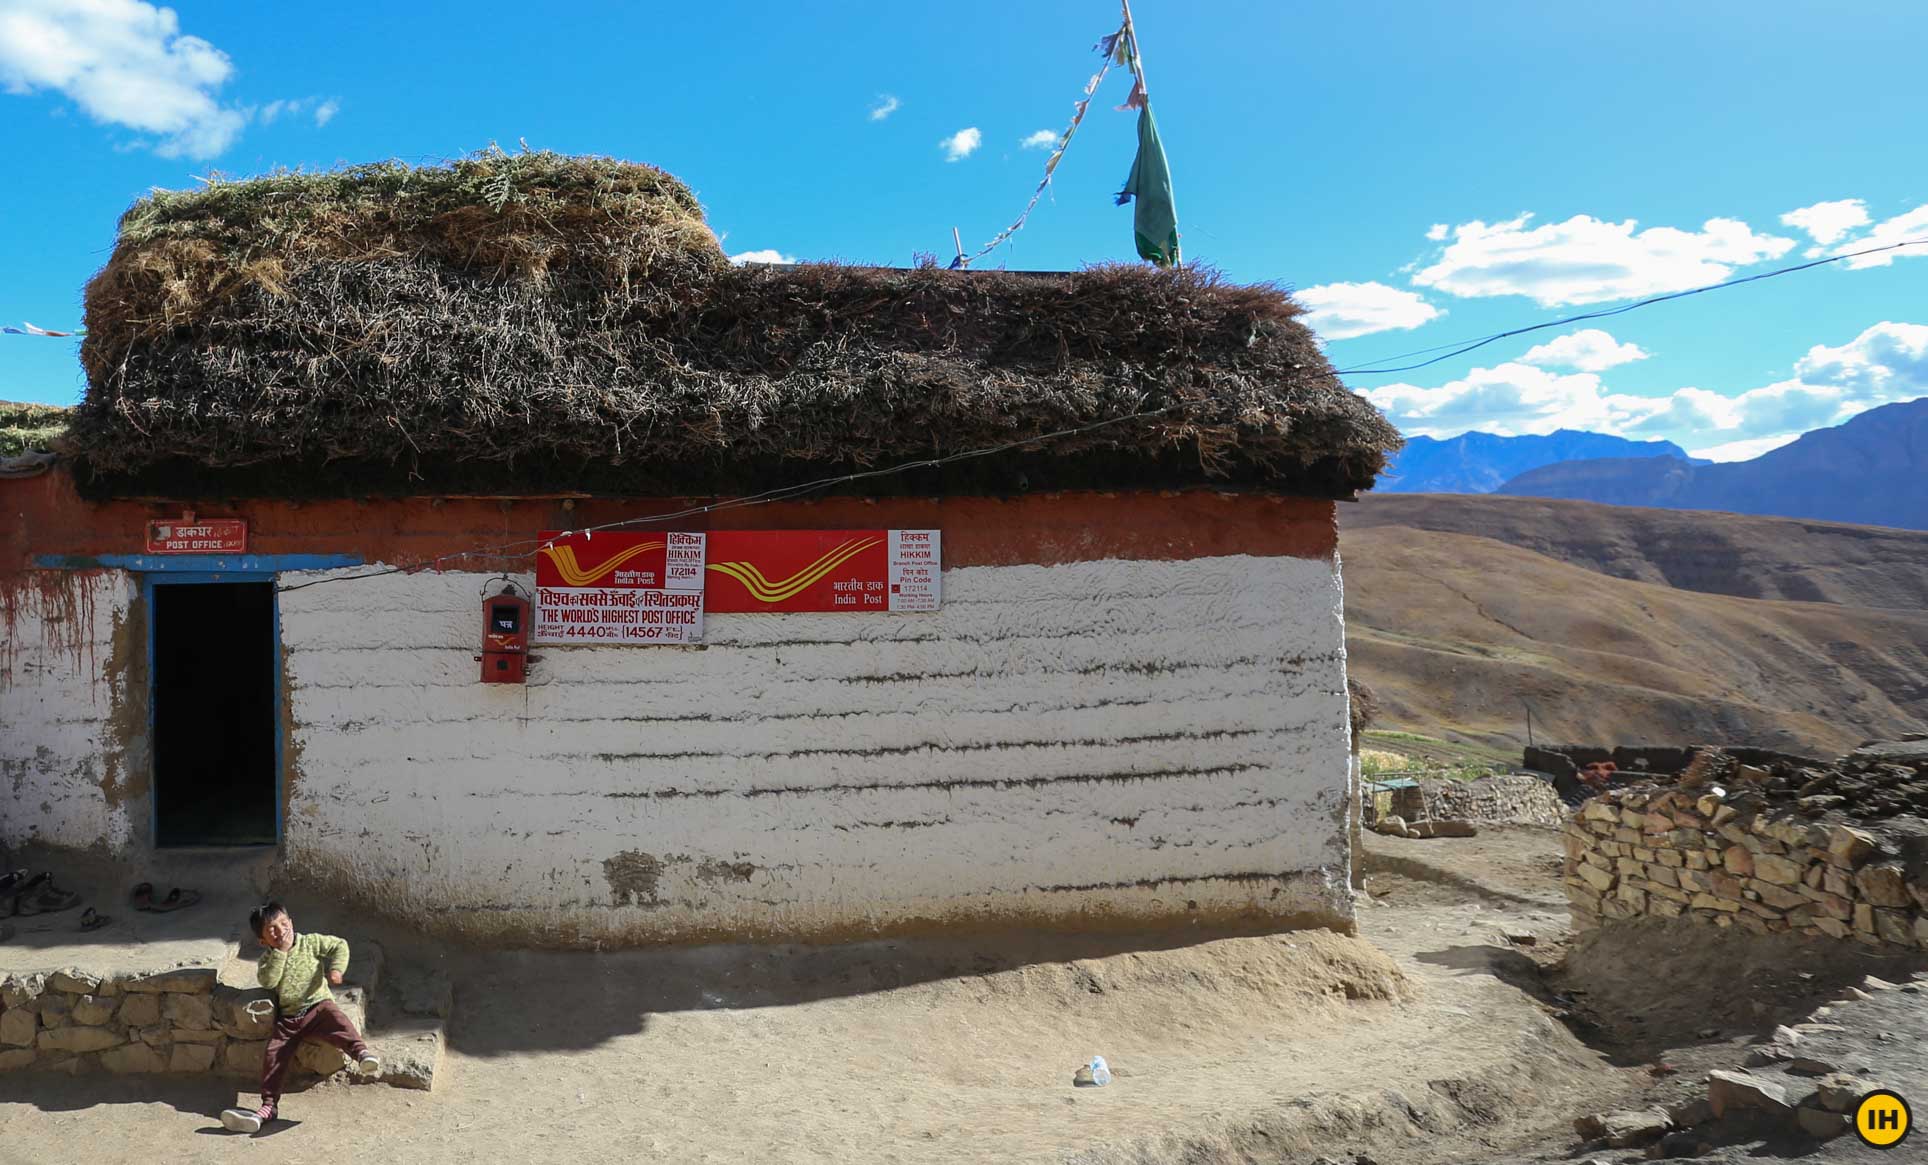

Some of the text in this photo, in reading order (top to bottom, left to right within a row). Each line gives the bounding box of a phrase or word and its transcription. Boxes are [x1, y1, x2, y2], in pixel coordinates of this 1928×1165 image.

[166, 540, 189, 549] POST
[192, 540, 222, 549] OFFICE
[668, 550, 701, 559] HIKKIM
[671, 567, 696, 576] 172114
[614, 577, 656, 585] India Post
[833, 578, 884, 591] भारतीय डाक
[834, 594, 882, 604] India Post
[601, 609, 640, 624] HIGHEST
[642, 610, 664, 624] POST
[566, 625, 606, 637] 4440
